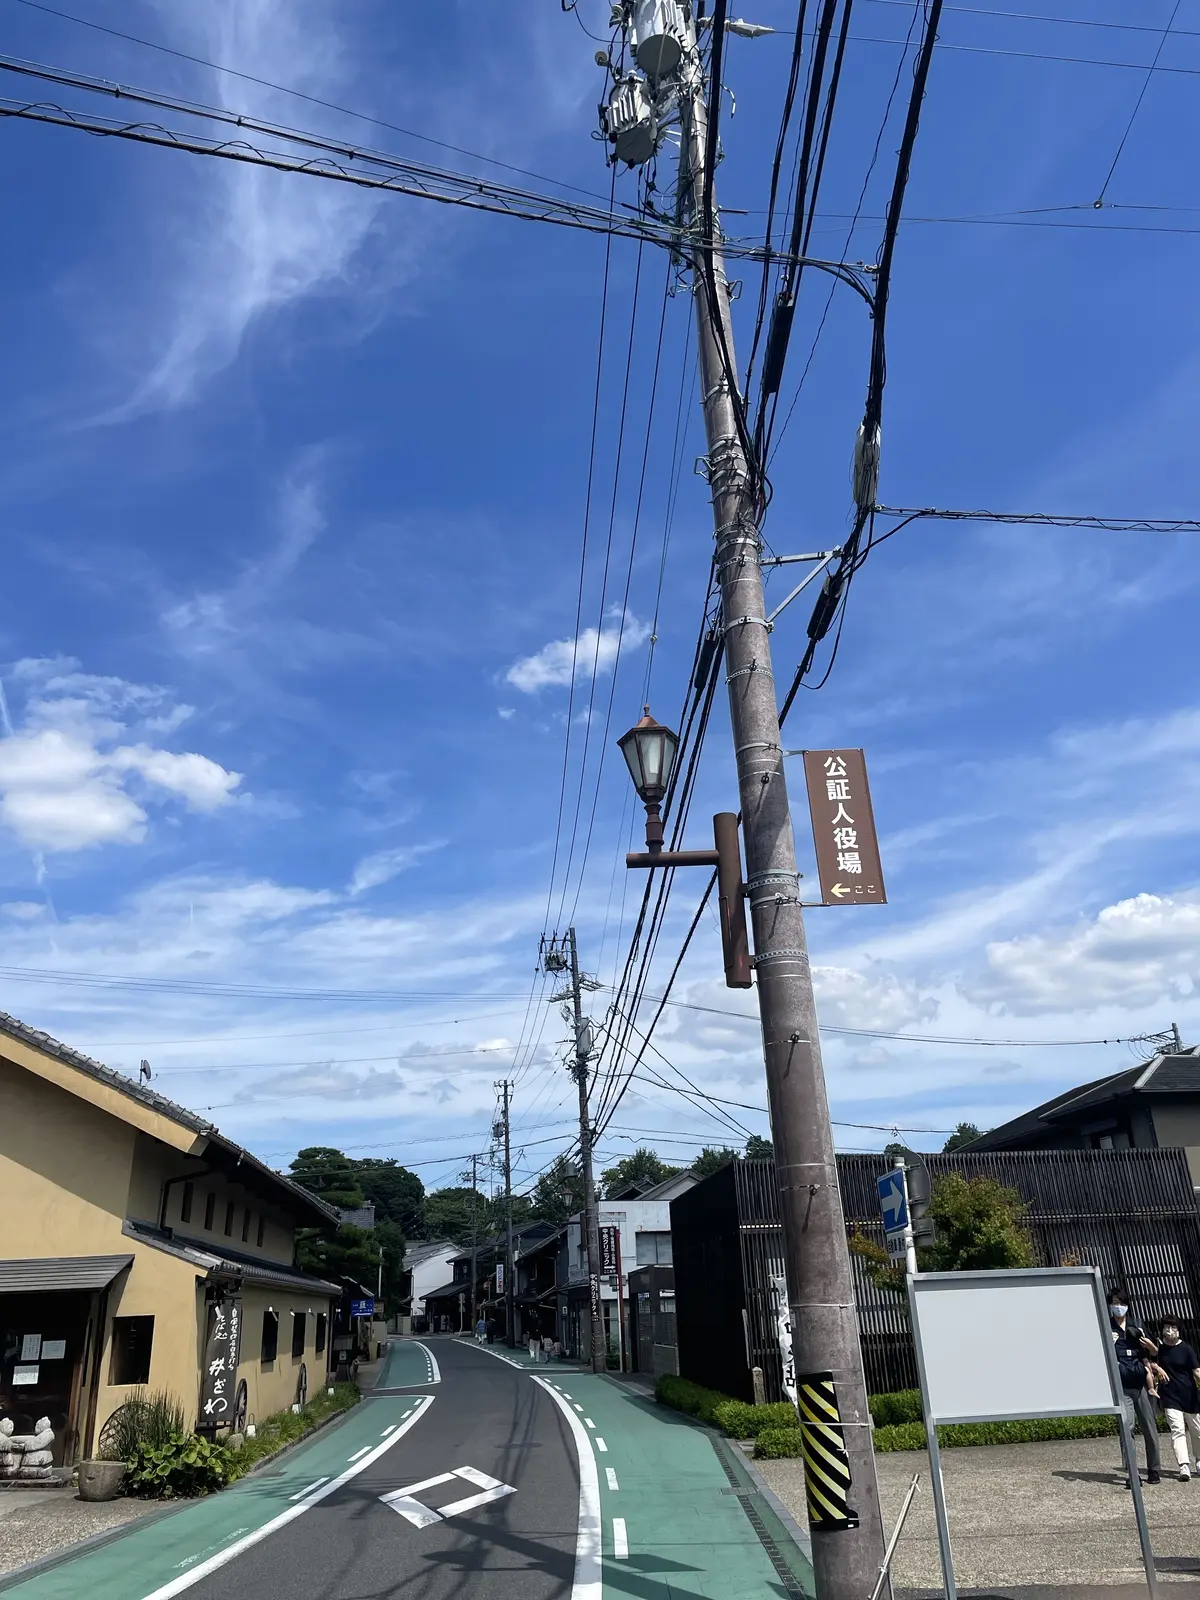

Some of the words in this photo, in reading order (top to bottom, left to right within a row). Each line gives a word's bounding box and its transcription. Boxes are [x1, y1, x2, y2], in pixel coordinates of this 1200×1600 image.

[823, 756, 863, 874] 公証人役場
[855, 885, 876, 894] ここ
